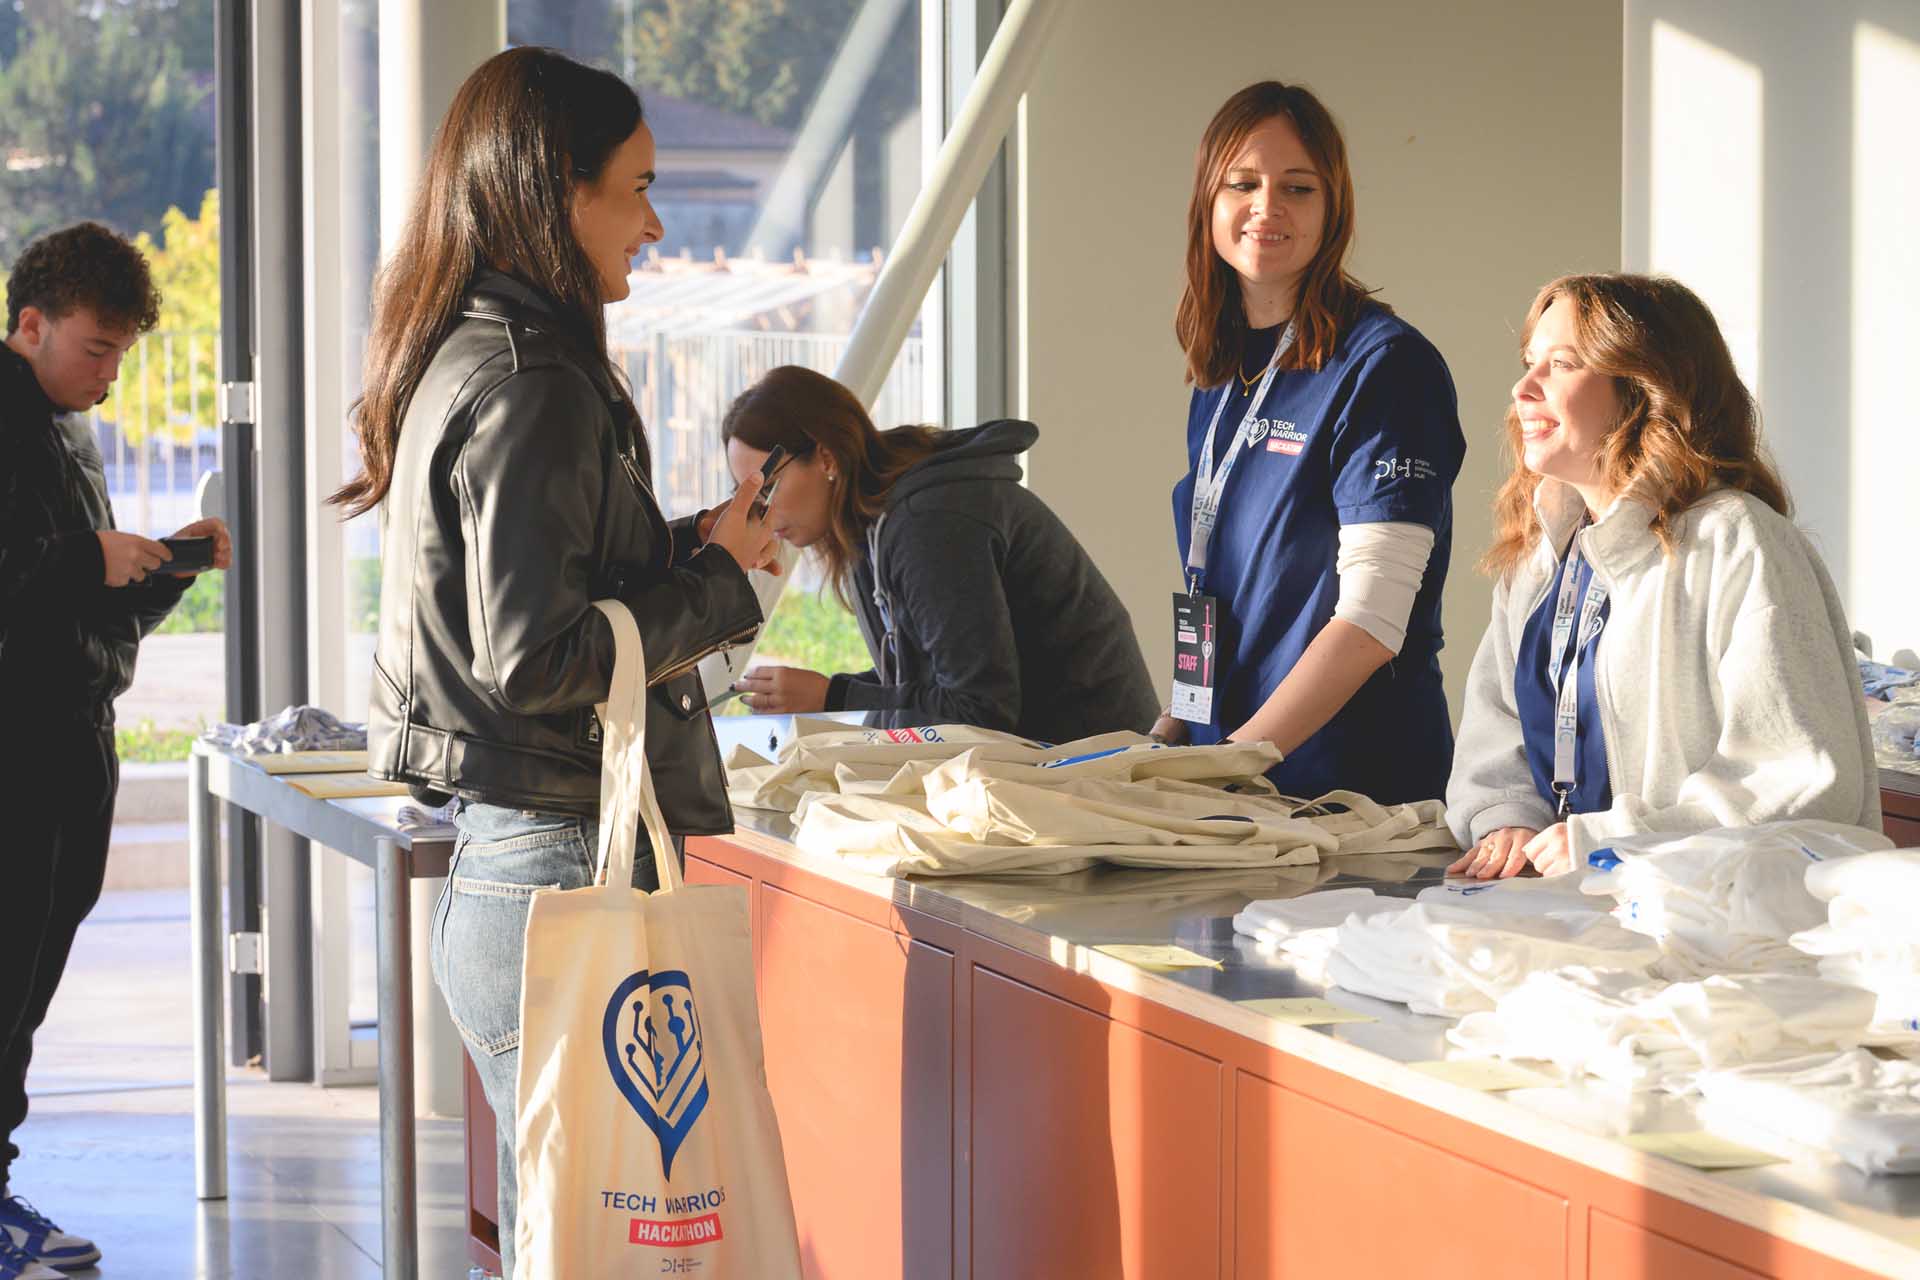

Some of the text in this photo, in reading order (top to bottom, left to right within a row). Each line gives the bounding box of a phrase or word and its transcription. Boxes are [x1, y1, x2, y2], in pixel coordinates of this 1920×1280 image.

[1272, 419, 1295, 431] TECH
[1270, 428, 1308, 442] WARRIOR
[1178, 653, 1199, 672] STAFF
[601, 1191, 656, 1213] TECH
